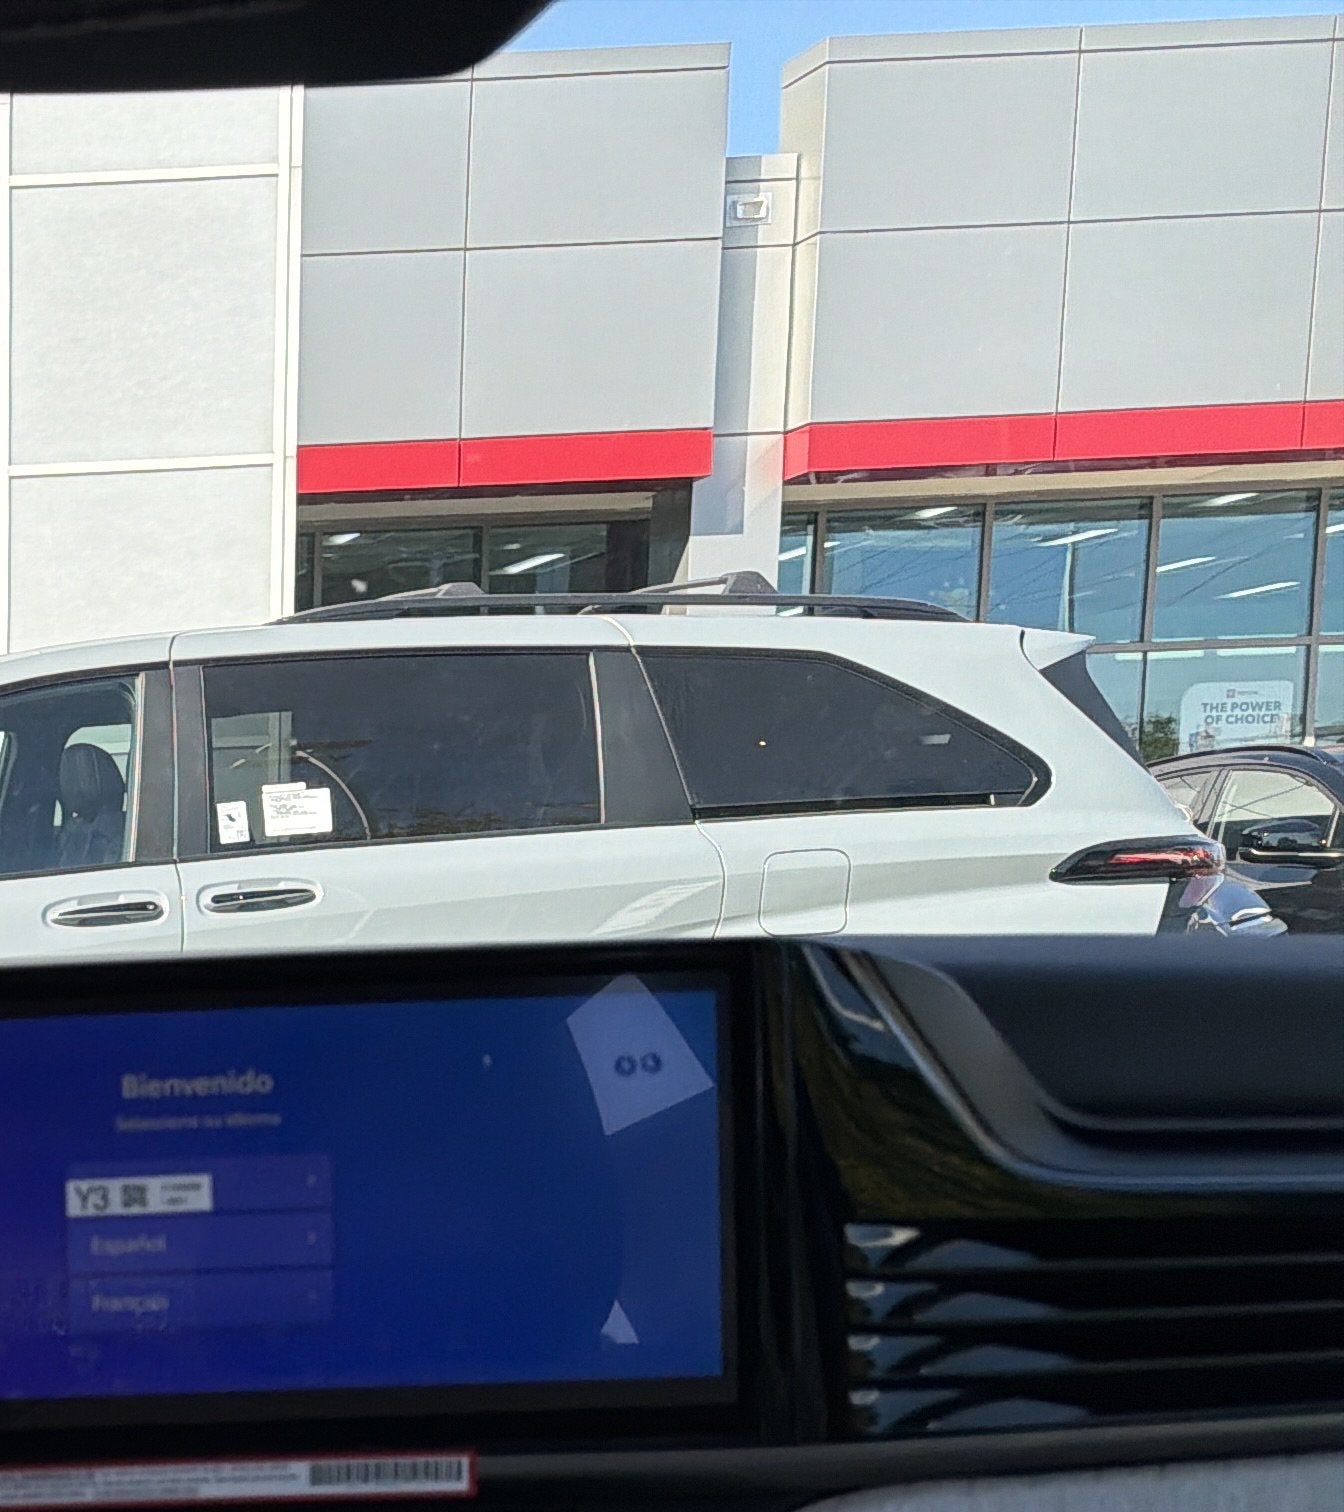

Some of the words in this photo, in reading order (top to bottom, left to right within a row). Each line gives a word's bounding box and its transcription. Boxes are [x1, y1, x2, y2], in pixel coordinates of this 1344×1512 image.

[1200, 702, 1229, 713] THE
[1230, 700, 1282, 713] POWER
[1204, 714, 1223, 725] OF
[121, 1069, 274, 1099] Bienvenido
[72, 1183, 111, 1212] Y3
